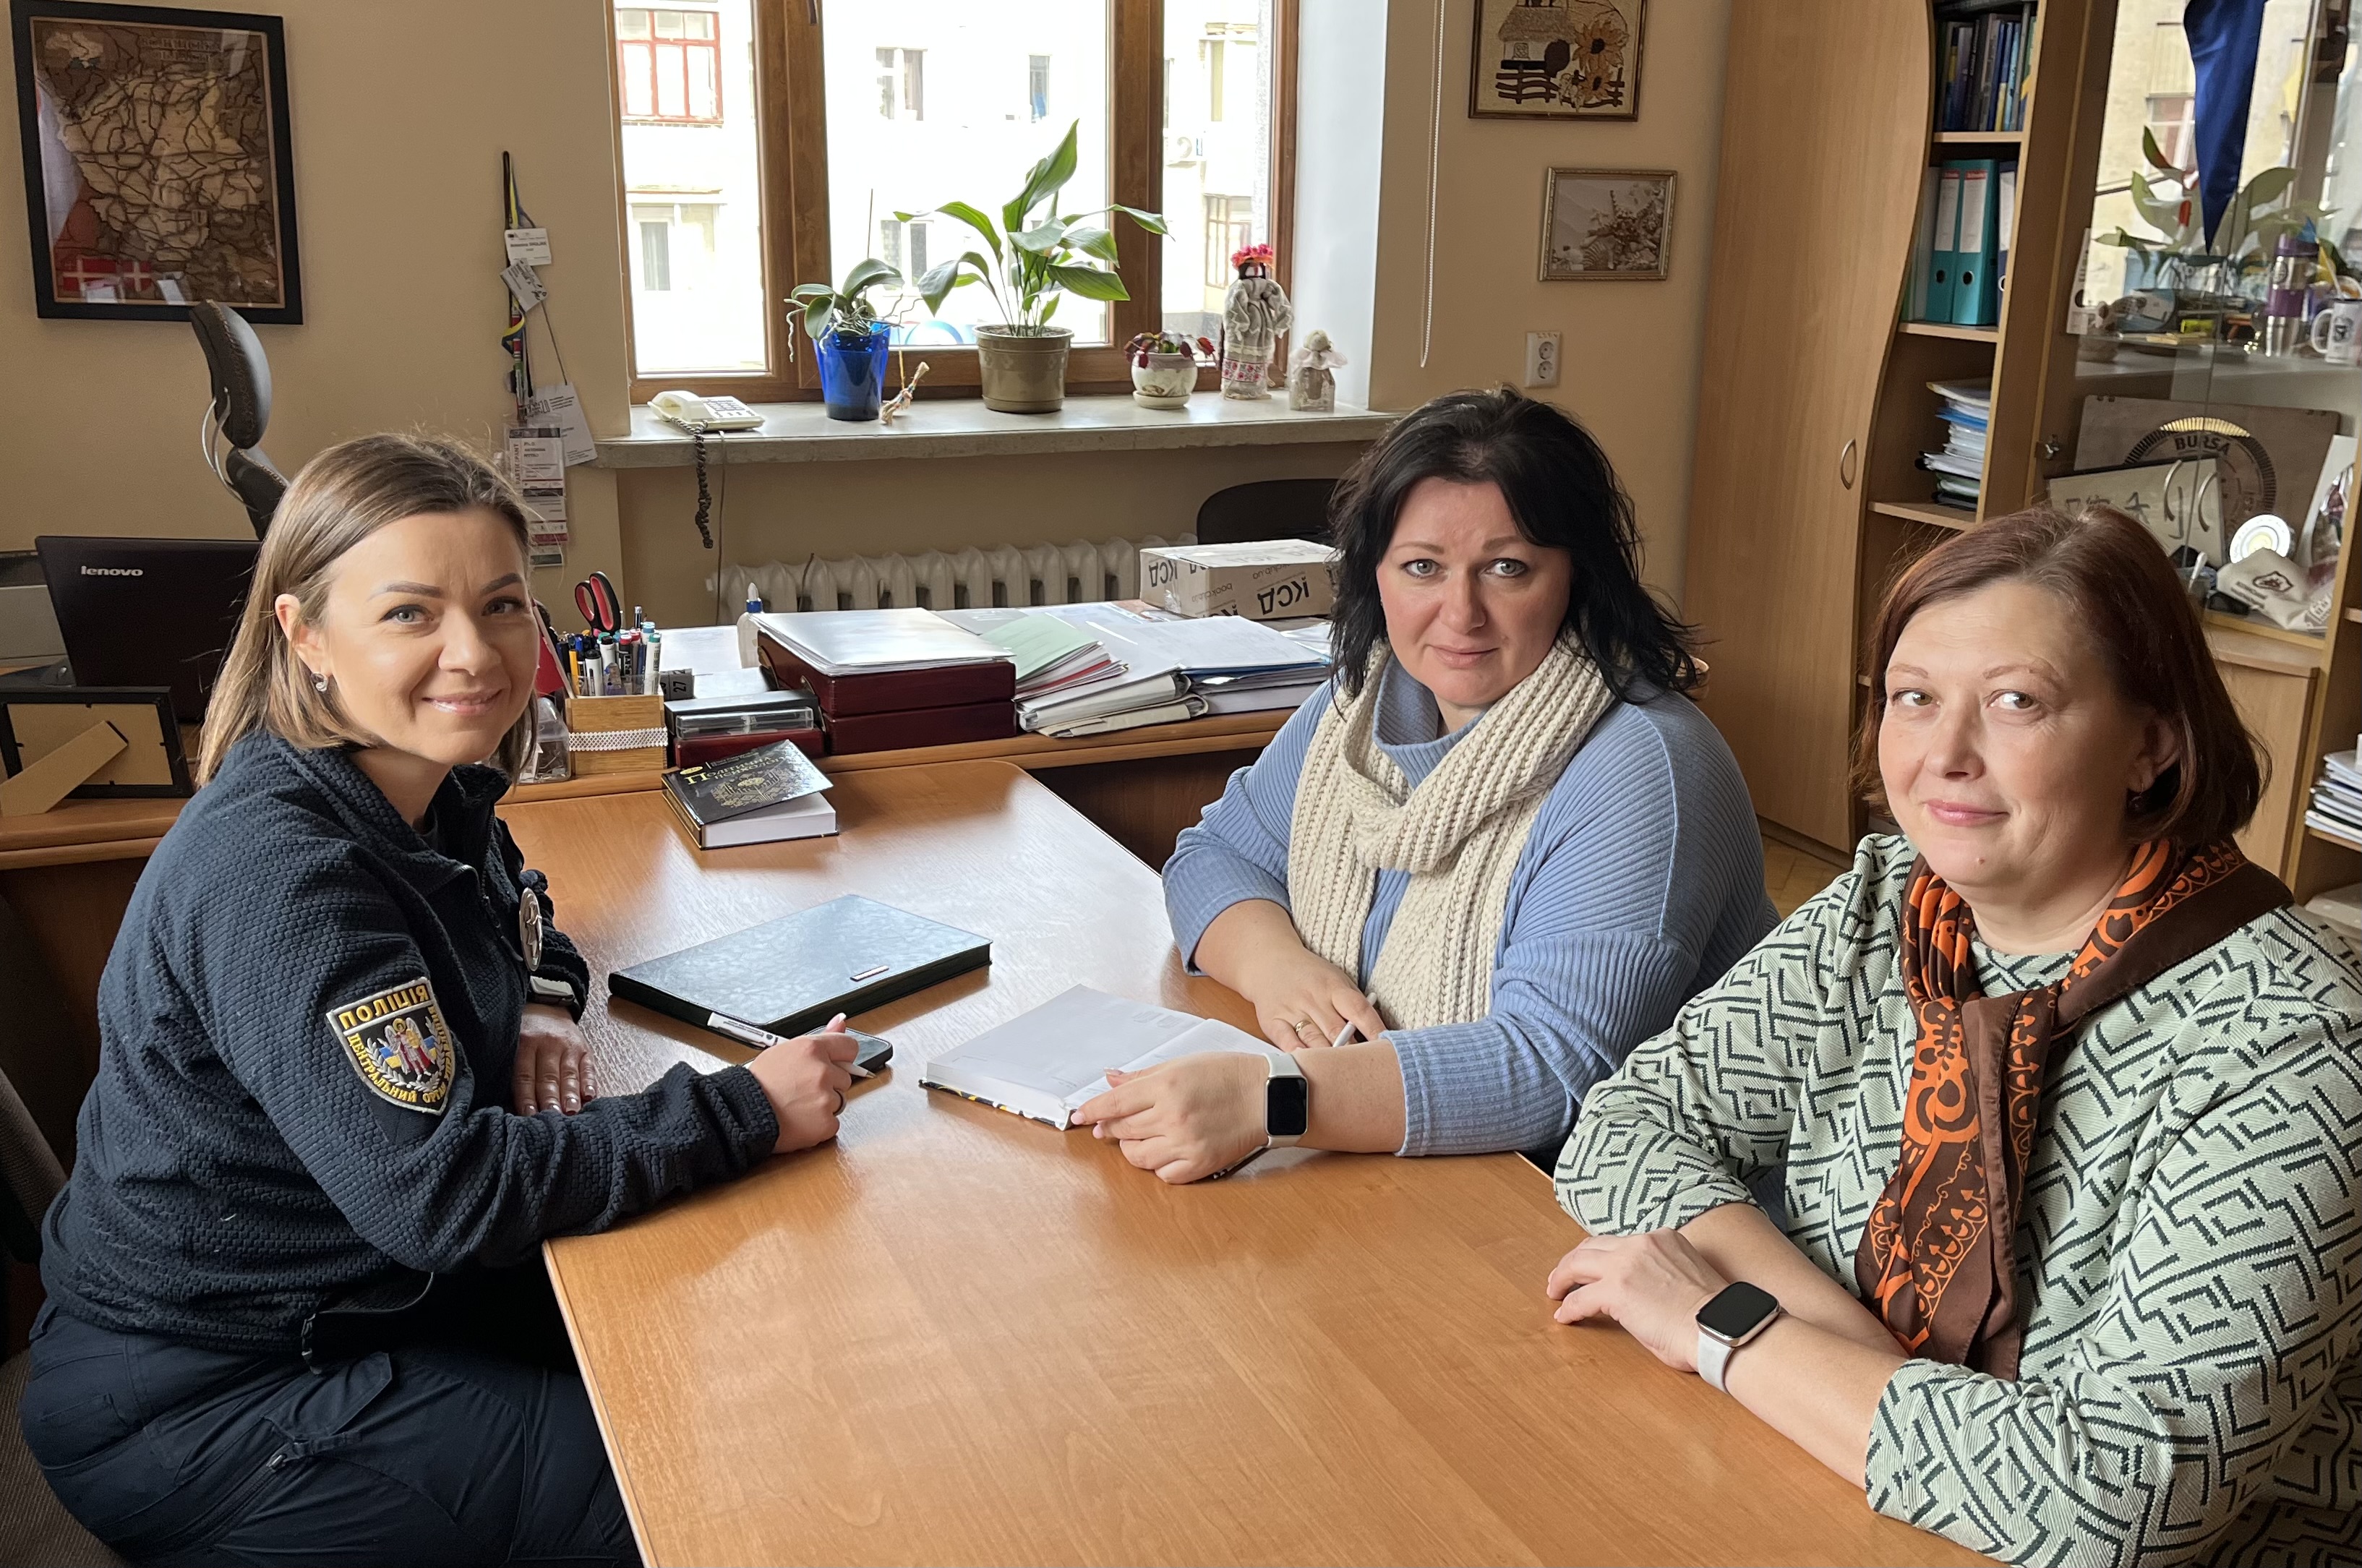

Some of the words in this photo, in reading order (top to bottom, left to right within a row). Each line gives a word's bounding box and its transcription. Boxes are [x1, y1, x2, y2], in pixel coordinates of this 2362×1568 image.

[81, 565, 143, 576] lenovo
[1149, 560, 1178, 587] КСД
[1257, 578, 1309, 615] КСД
[673, 681, 687, 693] 27
[338, 985, 430, 1030] ПОЛІЦІЯ
[347, 1032, 417, 1103] ЦЕНТРАЛЬНИЙ
